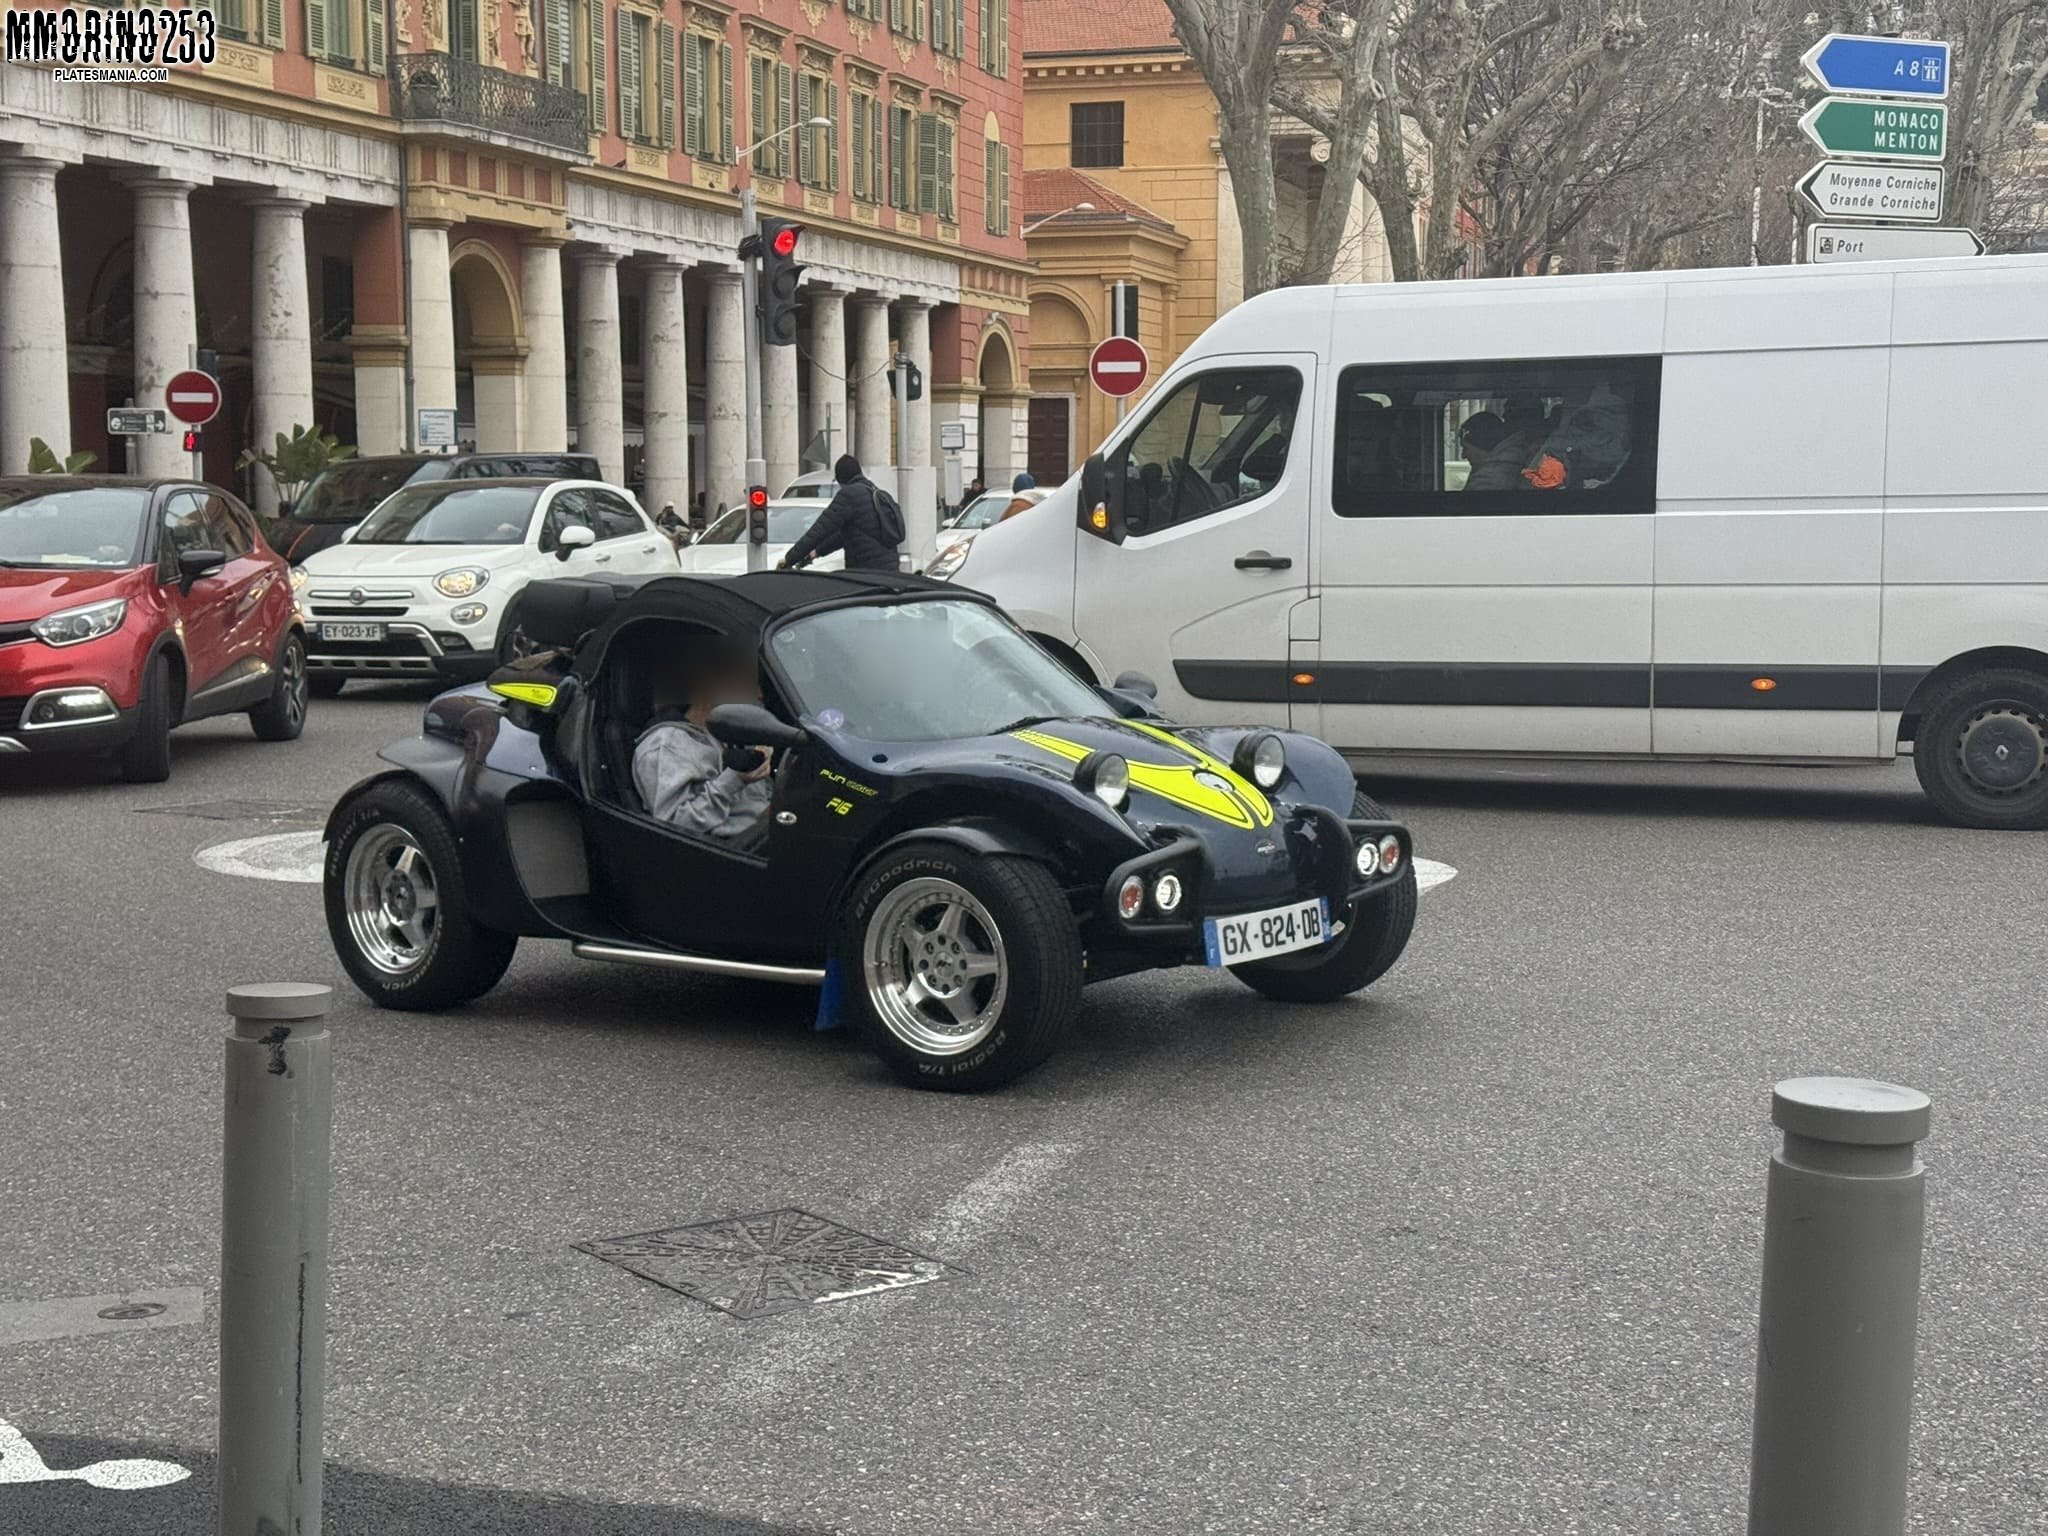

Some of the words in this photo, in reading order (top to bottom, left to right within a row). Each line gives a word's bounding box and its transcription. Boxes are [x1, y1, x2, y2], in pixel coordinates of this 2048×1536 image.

[1874, 110, 1939, 130] MONACO
[1874, 132, 1938, 150] MENTON
[1829, 173, 1882, 188] Moyenne
[1886, 176, 1937, 191] Corniche
[1829, 192, 1874, 208] Grande
[1880, 195, 1936, 210] Corniche
[1837, 239, 1864, 253] Port
[324, 625, 378, 638] EY-023-XF
[1222, 906, 1321, 956] GX-824-DB
